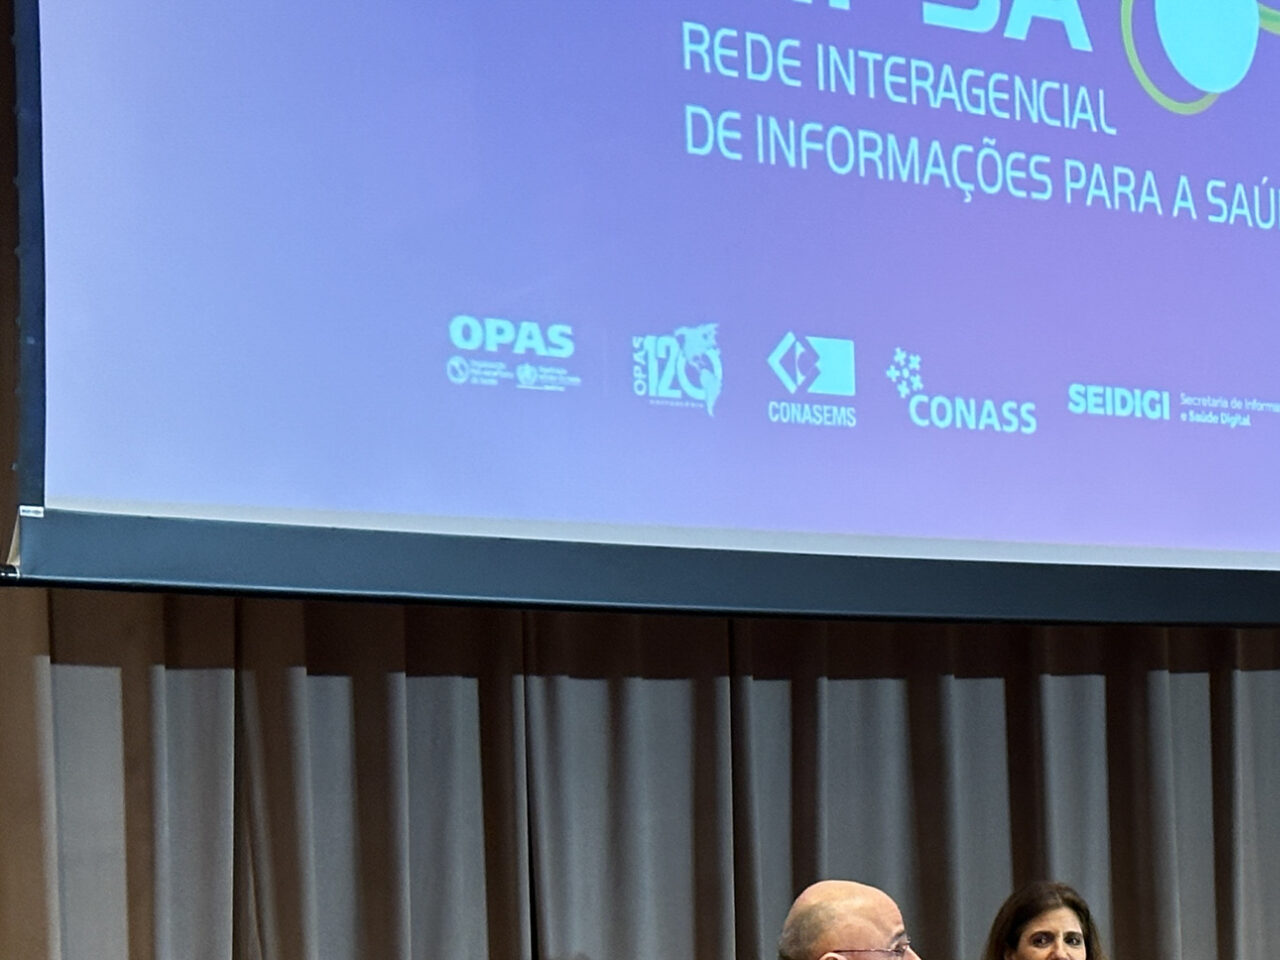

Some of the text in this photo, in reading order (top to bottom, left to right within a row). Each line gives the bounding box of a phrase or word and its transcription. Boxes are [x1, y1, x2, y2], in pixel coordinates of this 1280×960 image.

[682, 21, 802, 88] REDE
[816, 43, 1117, 136] INTERAGENCIAL
[685, 105, 743, 161] DE
[757, 115, 1052, 203] INFORMAÇÕES
[1064, 159, 1164, 216] PARA
[1172, 175, 1198, 220] A
[449, 315, 575, 359] OPAS
[632, 336, 646, 396] OPAS
[768, 401, 857, 428] CONASEMS
[909, 395, 1037, 434] CONASS
[1068, 383, 1170, 420] SEIDIGI
